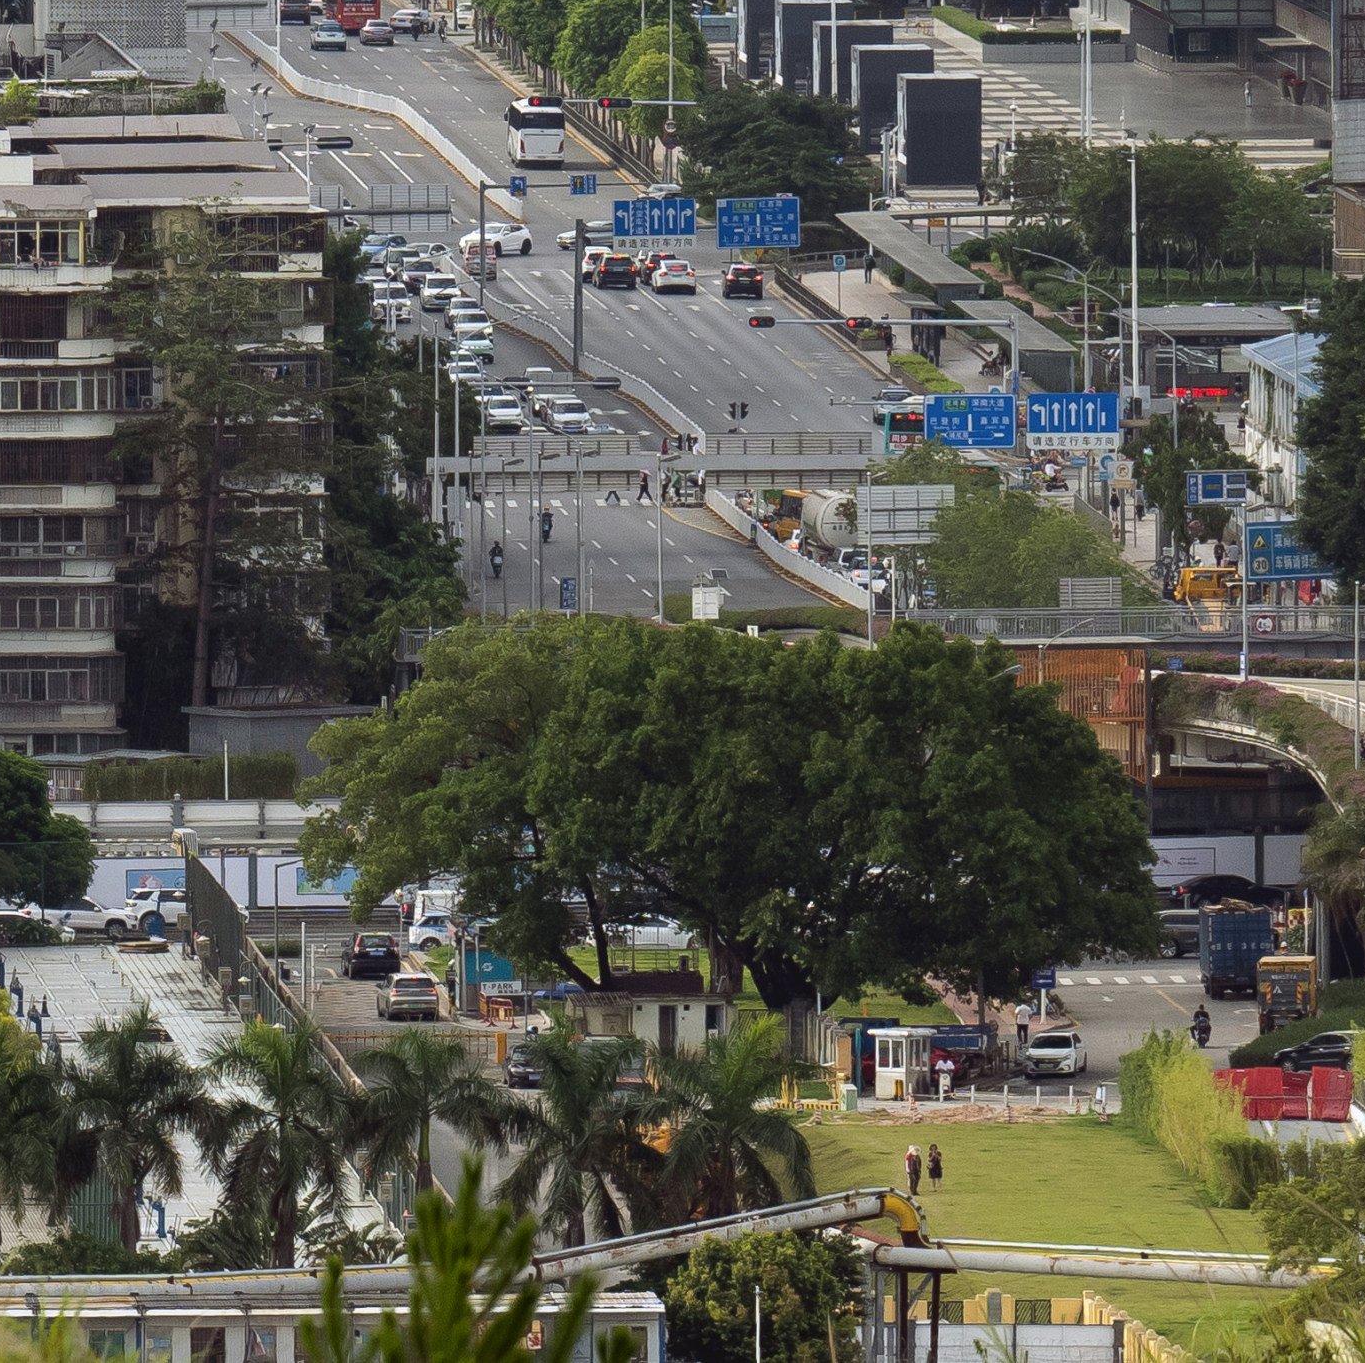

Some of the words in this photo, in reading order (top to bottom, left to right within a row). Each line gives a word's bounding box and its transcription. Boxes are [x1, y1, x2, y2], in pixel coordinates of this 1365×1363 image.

[617, 238, 693, 248] 请选定行车方向
[1032, 436, 1115, 446] 请选定行车方向
[1254, 560, 1267, 570] 30
